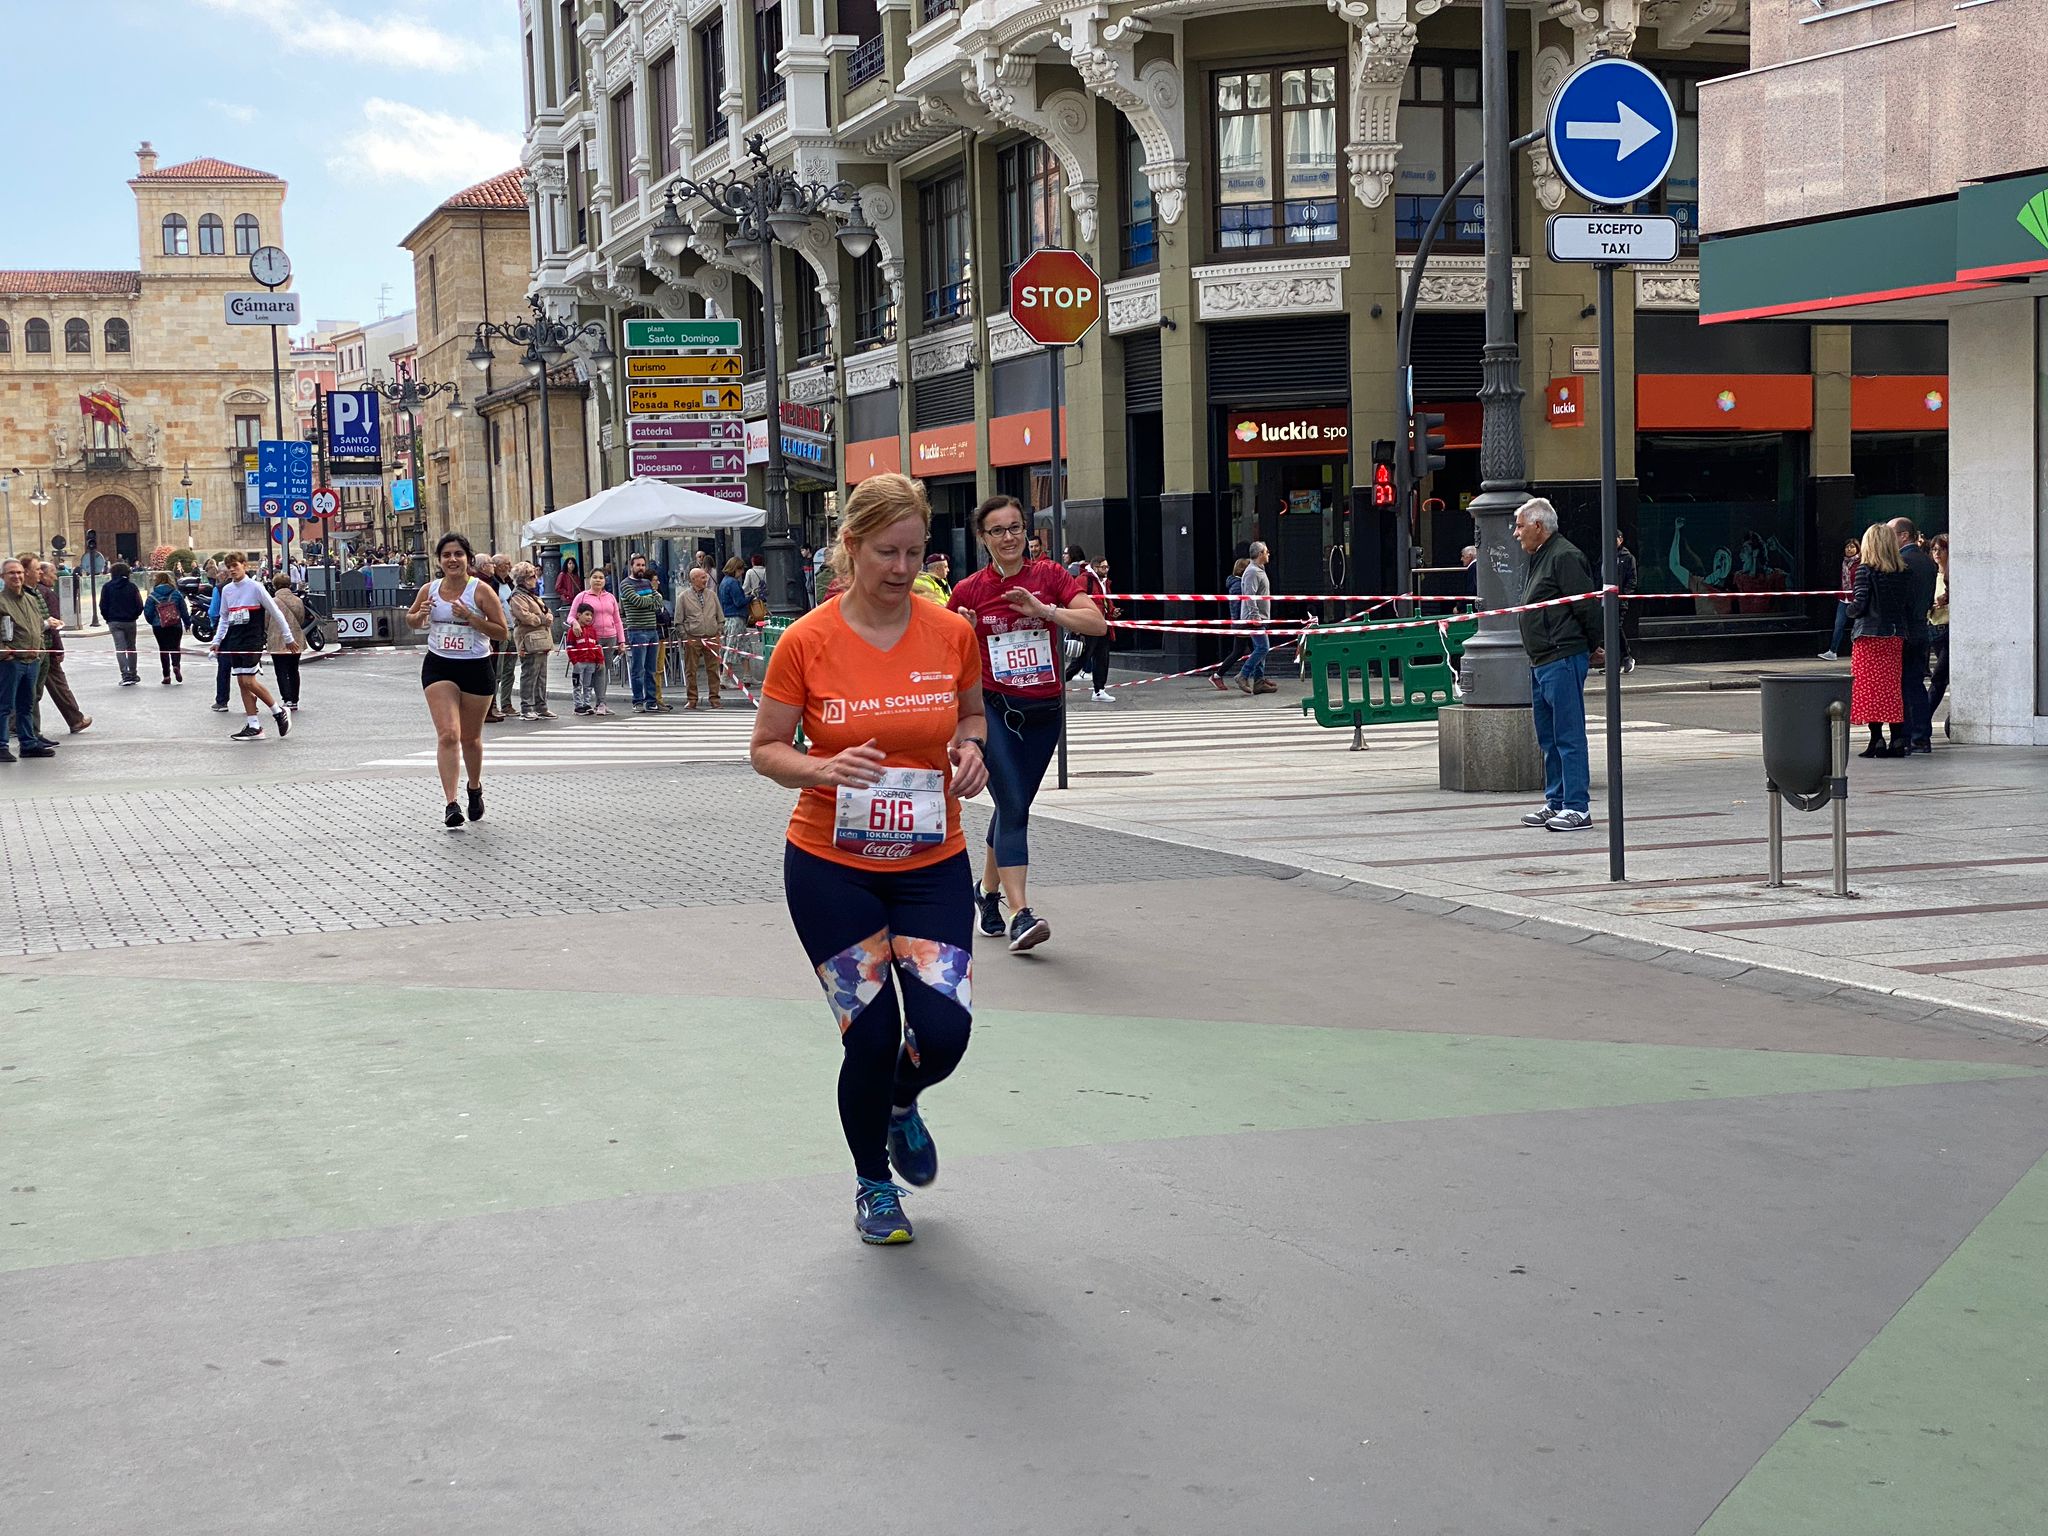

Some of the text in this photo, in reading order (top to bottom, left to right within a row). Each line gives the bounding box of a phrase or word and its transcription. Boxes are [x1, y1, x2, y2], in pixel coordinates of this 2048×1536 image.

[1588, 223, 1643, 235] EXCEPTO
[1601, 243, 1630, 254] TAXI
[1020, 286, 1092, 309] STOP
[647, 326, 665, 334] plaza
[648, 333, 720, 344] Santo Domingo
[632, 362, 666, 372] turismo
[632, 390, 657, 399] Paris
[632, 400, 701, 410] Posada Regia
[1553, 402, 1576, 415] luckia
[333, 393, 359, 435] P
[635, 426, 673, 436] catedral
[1261, 420, 1348, 441] luckia spo
[340, 436, 370, 444] SANTO
[333, 445, 377, 453] DOMINGO
[637, 463, 683, 472] Diocesano
[713, 489, 742, 499] Isidoro
[1376, 485, 1392, 503] 37
[443, 636, 464, 649] 645
[1007, 648, 1038, 669] 650
[848, 691, 955, 712] VAN SCHUPPEN
[873, 790, 913, 799] JOSEPHINE
[869, 798, 914, 831] 616
[866, 831, 913, 839] 10KMLEON
[863, 841, 915, 857] Coca-Cola
